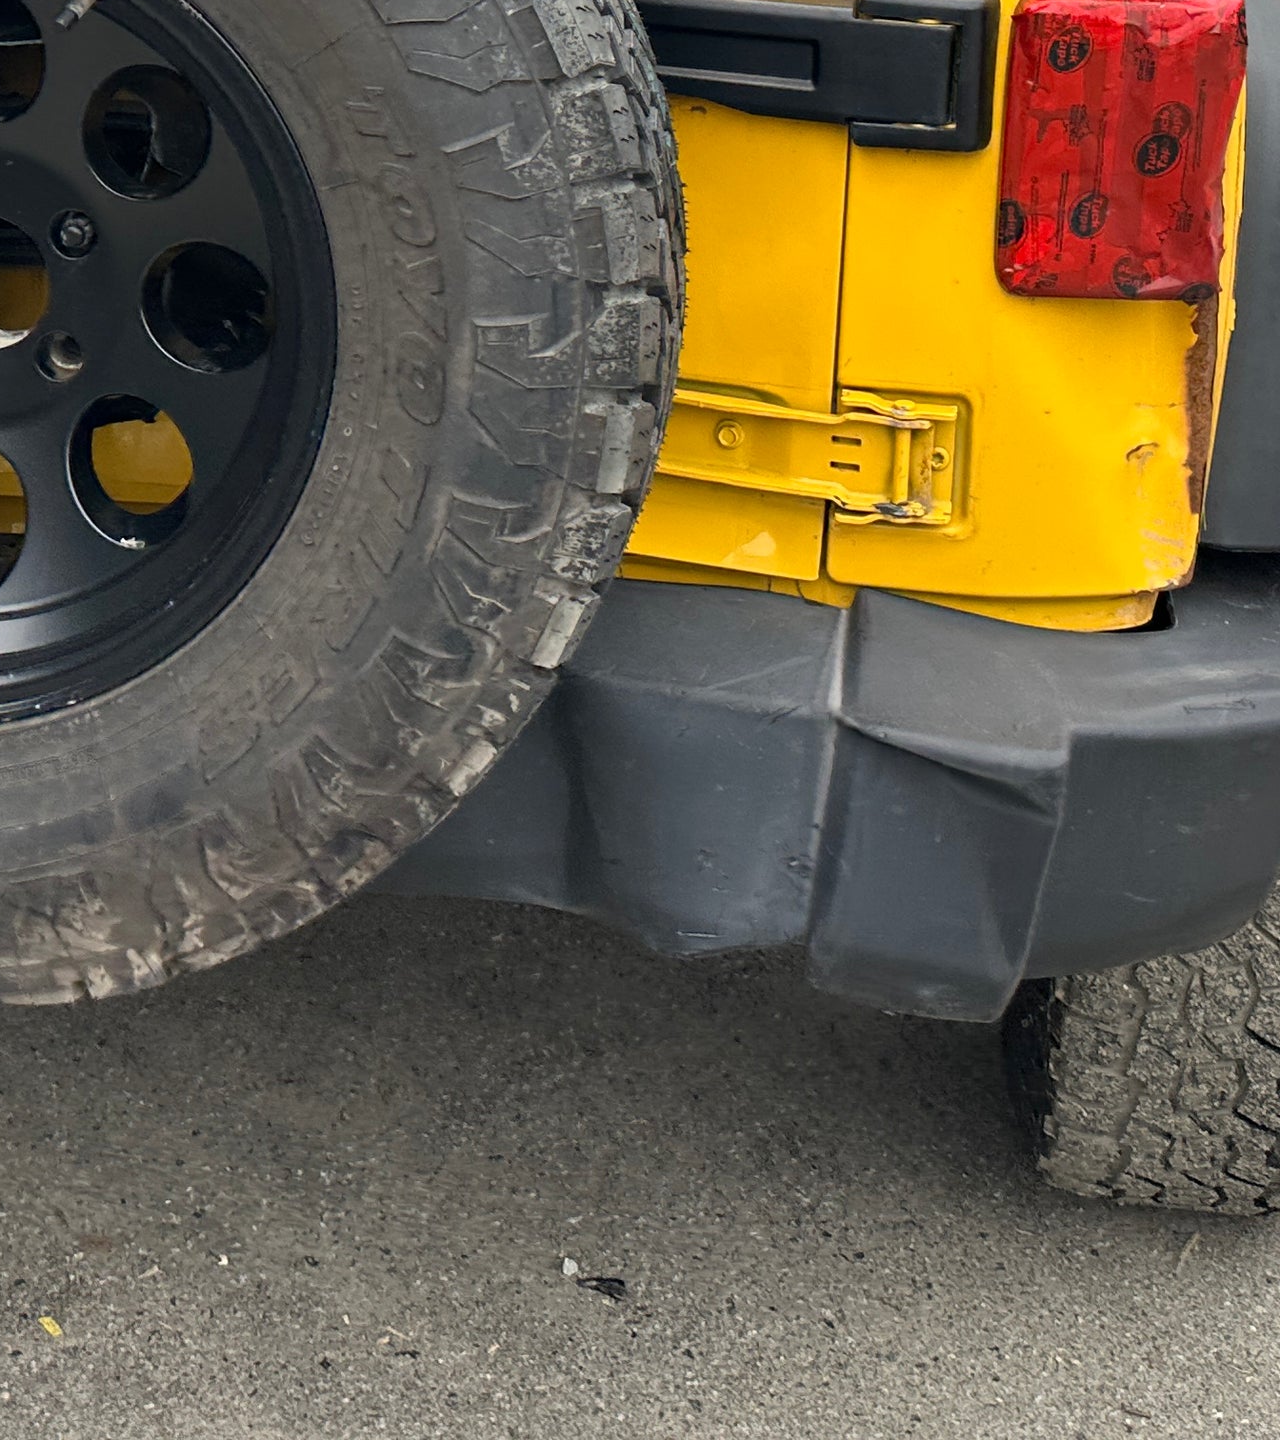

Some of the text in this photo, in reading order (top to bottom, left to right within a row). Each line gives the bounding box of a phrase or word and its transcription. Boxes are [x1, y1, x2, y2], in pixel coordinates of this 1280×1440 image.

[1070, 29, 1083, 64] Tuck
[1144, 141, 1158, 171] Tuck
[1090, 197, 1103, 229] Tuck
[343, 86, 448, 426] TOYO
